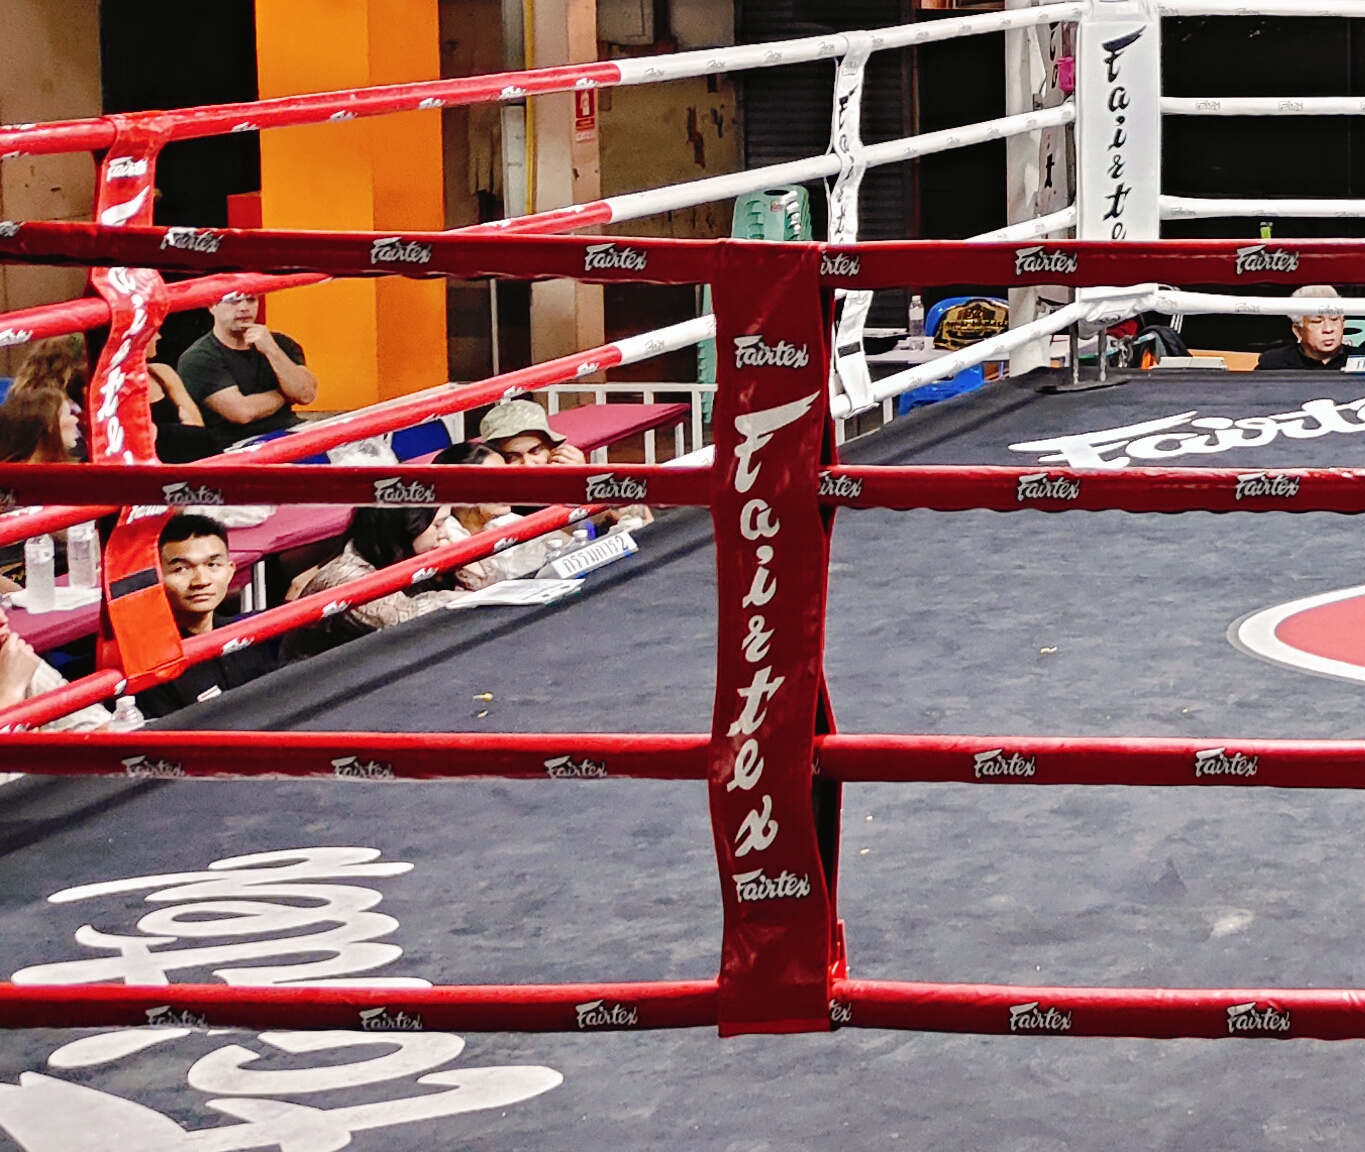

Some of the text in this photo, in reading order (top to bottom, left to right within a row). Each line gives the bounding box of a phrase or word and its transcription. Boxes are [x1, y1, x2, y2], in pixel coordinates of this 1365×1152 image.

[370, 236, 432, 266] Fairtex
[585, 241, 647, 272] Fairtex
[820, 250, 860, 276] irtex
[1014, 244, 1078, 276] Fairtex
[1235, 244, 1299, 275] Fairtex
[734, 335, 810, 369] Fairtex
[373, 477, 436, 504] Fairtex
[585, 472, 647, 501] Fairtex
[819, 471, 862, 498] irtex
[1016, 472, 1079, 501] Fairtex
[1235, 472, 1299, 499] Fairtex
[727, 390, 822, 860] Fairtex
[330, 754, 394, 780] Fairtex
[543, 754, 607, 779] Fairtex
[973, 747, 1036, 778] Fairtex
[1195, 747, 1258, 778] Fairtex
[733, 869, 811, 904] Fairtex
[358, 1006, 423, 1031] Fairtex
[575, 998, 639, 1027] Fairtex
[1009, 1001, 1073, 1032] Fairtex
[1226, 1001, 1290, 1033] Fairtex
